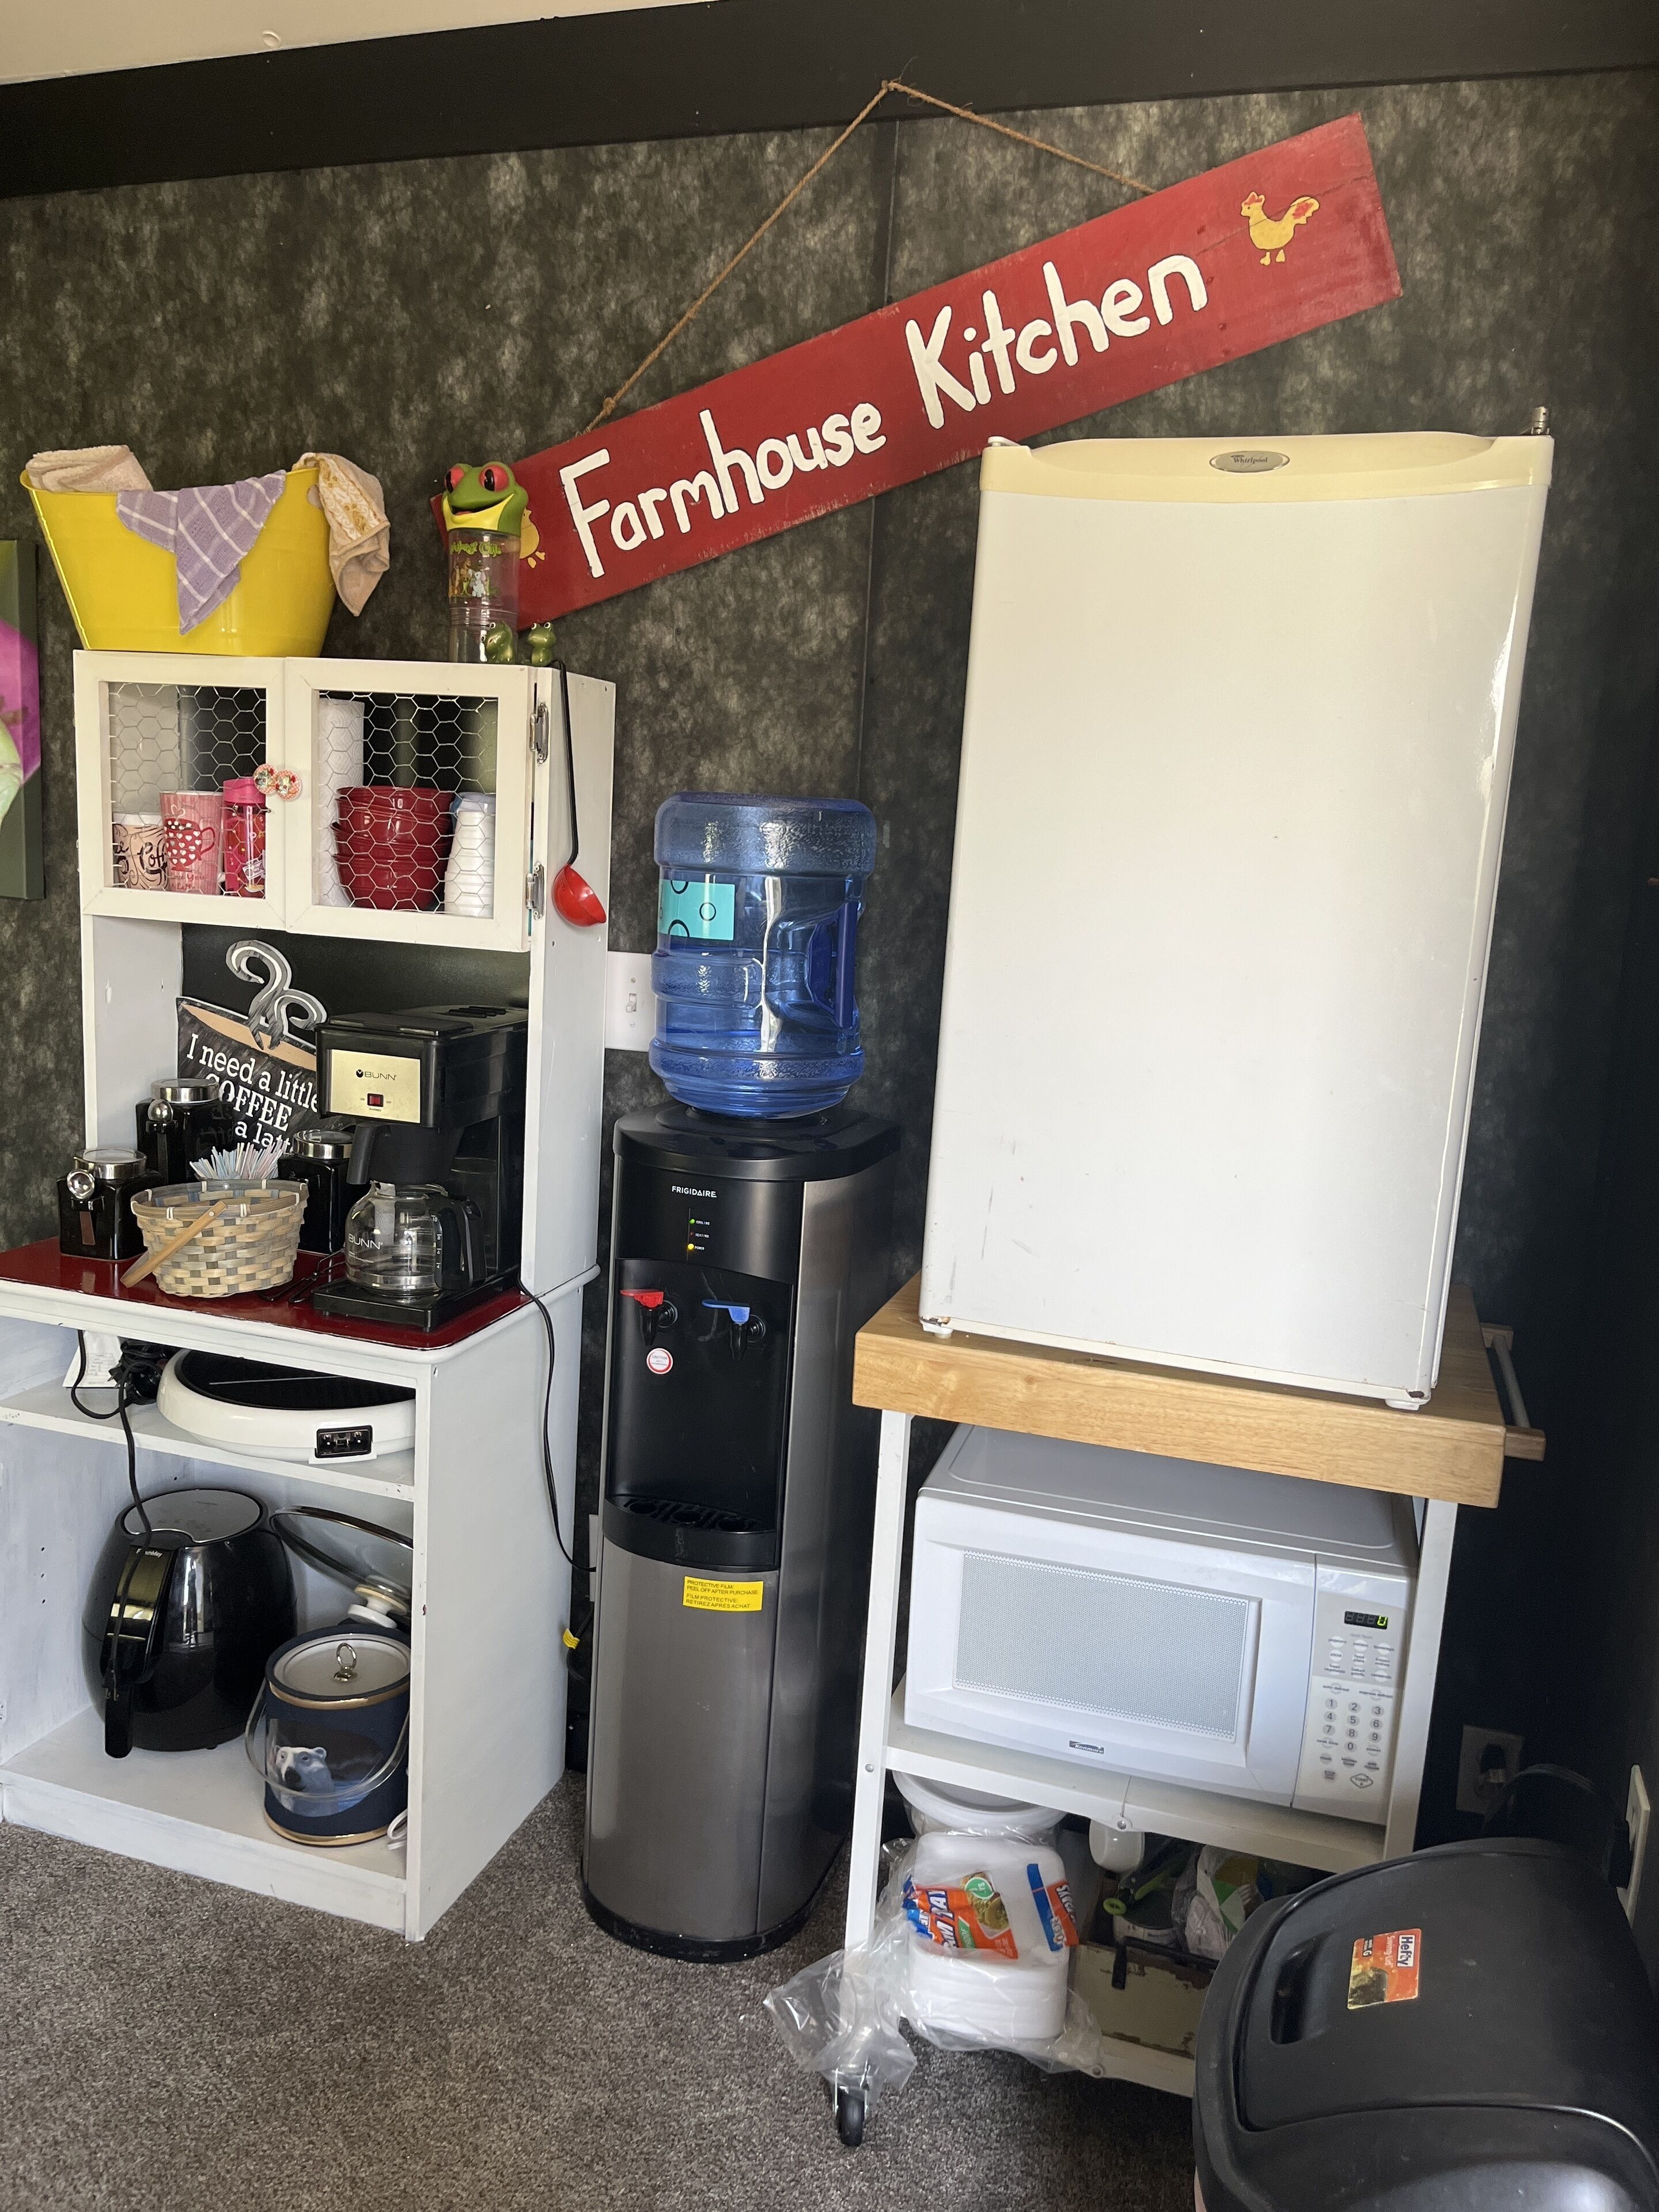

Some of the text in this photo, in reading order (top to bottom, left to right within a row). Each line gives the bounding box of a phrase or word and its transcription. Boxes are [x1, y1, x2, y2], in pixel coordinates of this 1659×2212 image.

[559, 254, 1209, 578] Farmhouse Kitchen
[1232, 456, 1268, 464] Whirlpool
[187, 1033, 317, 1113] I need a little
[364, 1071, 396, 1081] BUNN
[234, 1120, 291, 1149] a latt
[671, 1185, 717, 1198] FRIGIDAIRE
[348, 1233, 381, 1250] BUNN
[687, 1580, 719, 1589] PROTECTIVE
[1351, 1703, 1357, 1711] 2
[1374, 1706, 1381, 1714] 3
[1350, 1716, 1356, 1724] 5
[1373, 1719, 1379, 1728] 6
[1326, 1725, 1332, 1733] 7
[1349, 1729, 1355, 1737] 8
[1372, 1733, 1378, 1741] 9
[1074, 1744, 1104, 1753] Kenmore
[1347, 1742, 1353, 1751] 0
[1397, 1936, 1412, 1966] Hefty
